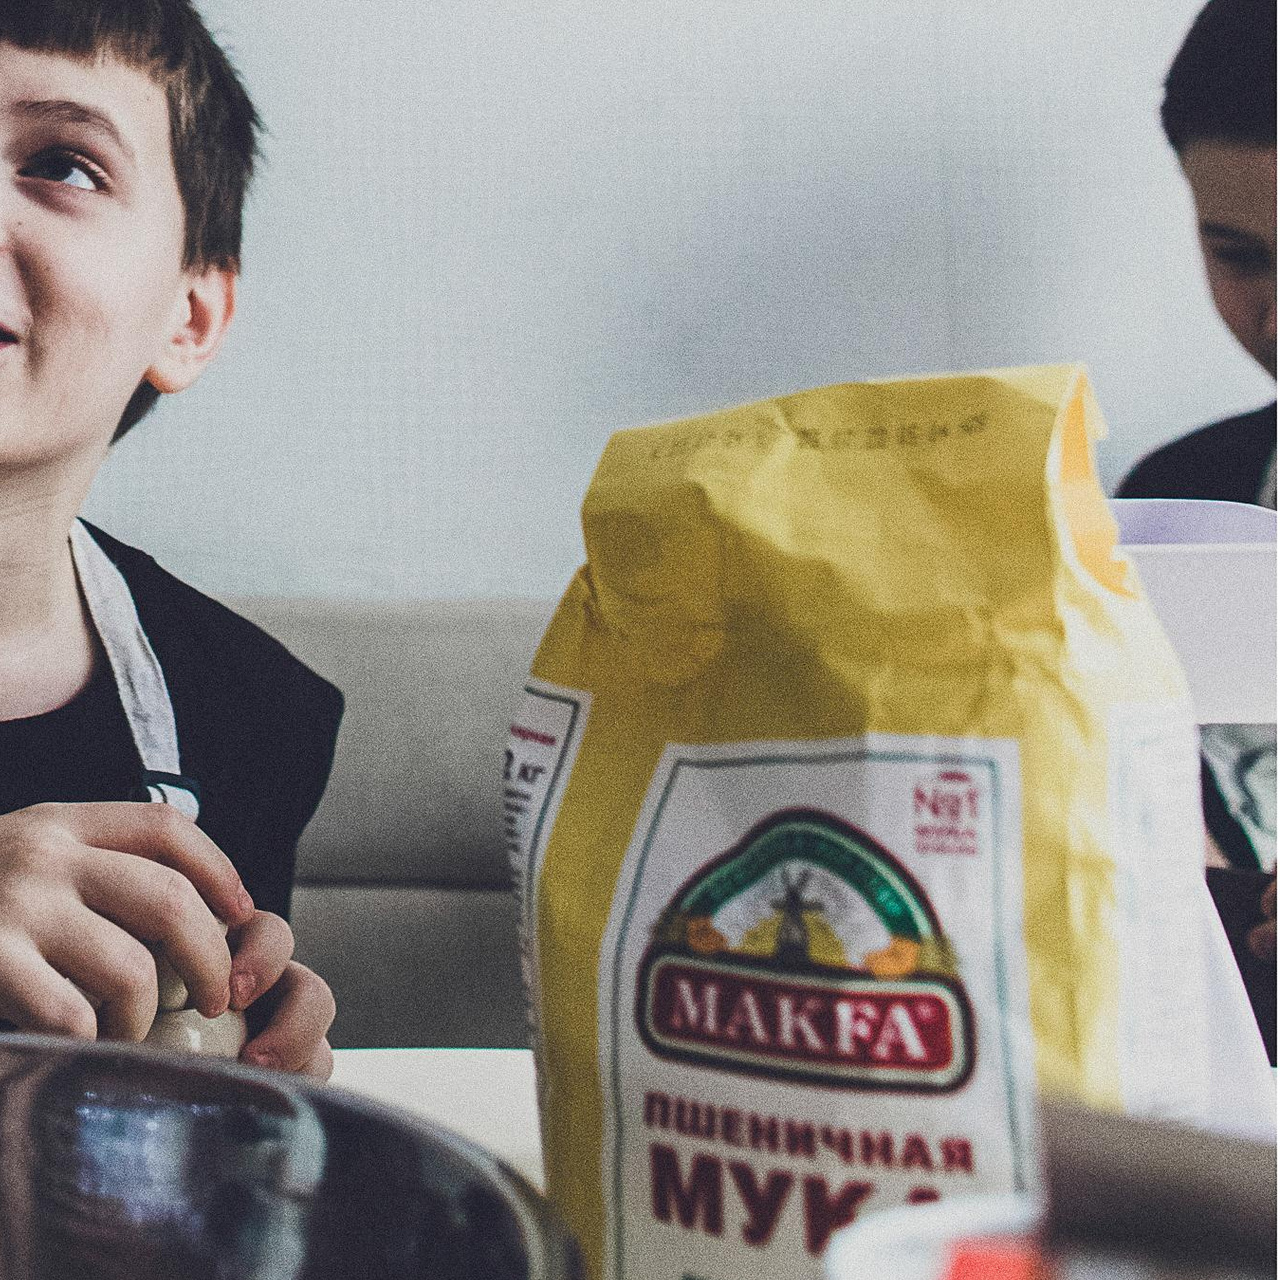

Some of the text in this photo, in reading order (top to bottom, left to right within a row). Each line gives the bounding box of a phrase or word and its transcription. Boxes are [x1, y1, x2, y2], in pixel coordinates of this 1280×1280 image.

[672, 977, 928, 1061] MAKFA
[644, 1090, 973, 1172] ПШЕНИЧНАЯ
[649, 1141, 941, 1257] МУК
